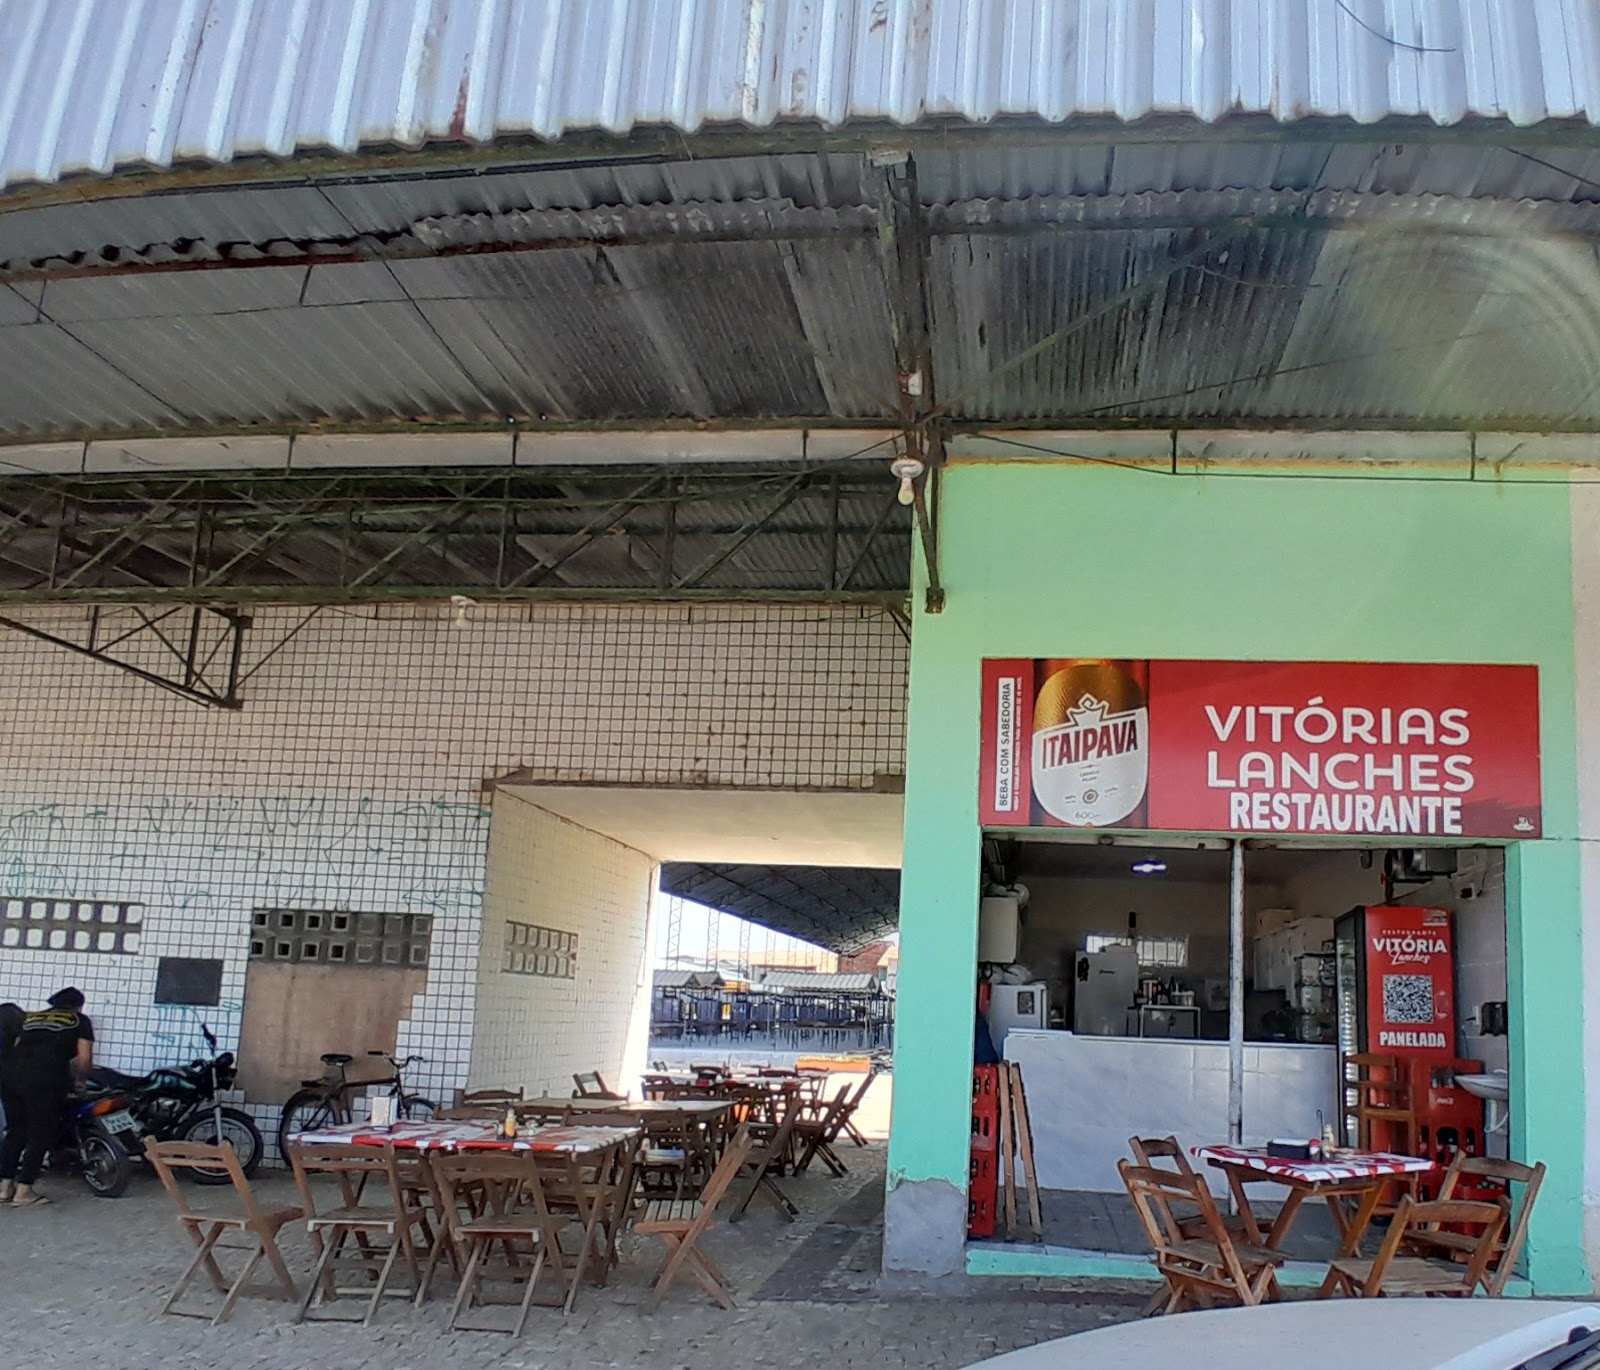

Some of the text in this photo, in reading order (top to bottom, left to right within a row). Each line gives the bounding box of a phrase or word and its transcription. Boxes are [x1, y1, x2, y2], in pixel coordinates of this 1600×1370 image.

[1204, 696, 1470, 746] VITÓRIAS
[999, 682, 1011, 806] BEBA COM SABEDORIA
[1042, 719, 1138, 770] ITAIPAVA
[1207, 751, 1475, 793] LANCHES
[1229, 792, 1463, 834] RESTAURANTE
[1372, 934, 1448, 954] VITÓRIA
[1388, 949, 1431, 966] Lanches
[1379, 1031, 1447, 1048] PANELADA
